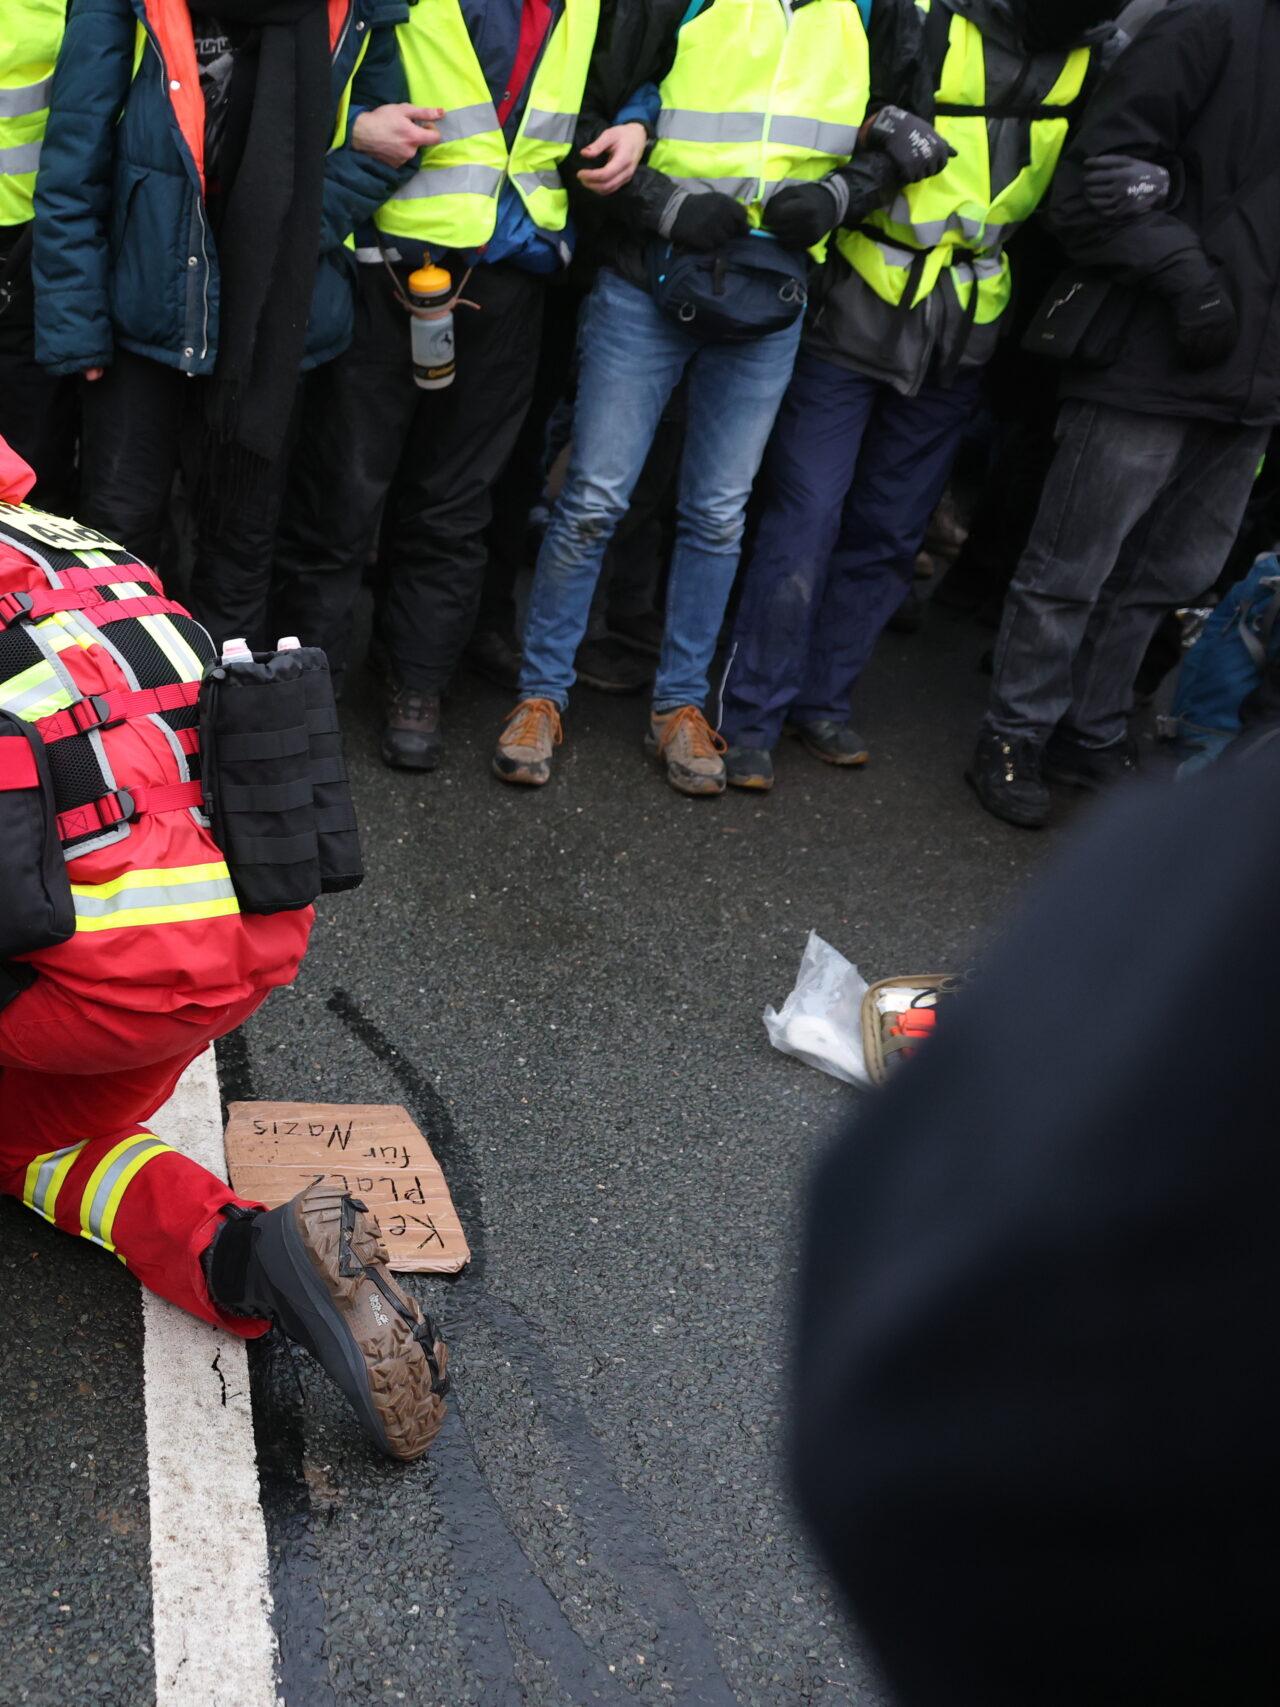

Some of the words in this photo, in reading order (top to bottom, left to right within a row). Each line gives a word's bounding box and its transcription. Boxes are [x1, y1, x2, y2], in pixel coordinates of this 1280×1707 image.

[253, 1120, 353, 1150] Nazis
[362, 1146, 411, 1168] für
[373, 1213, 445, 1249] Kei
